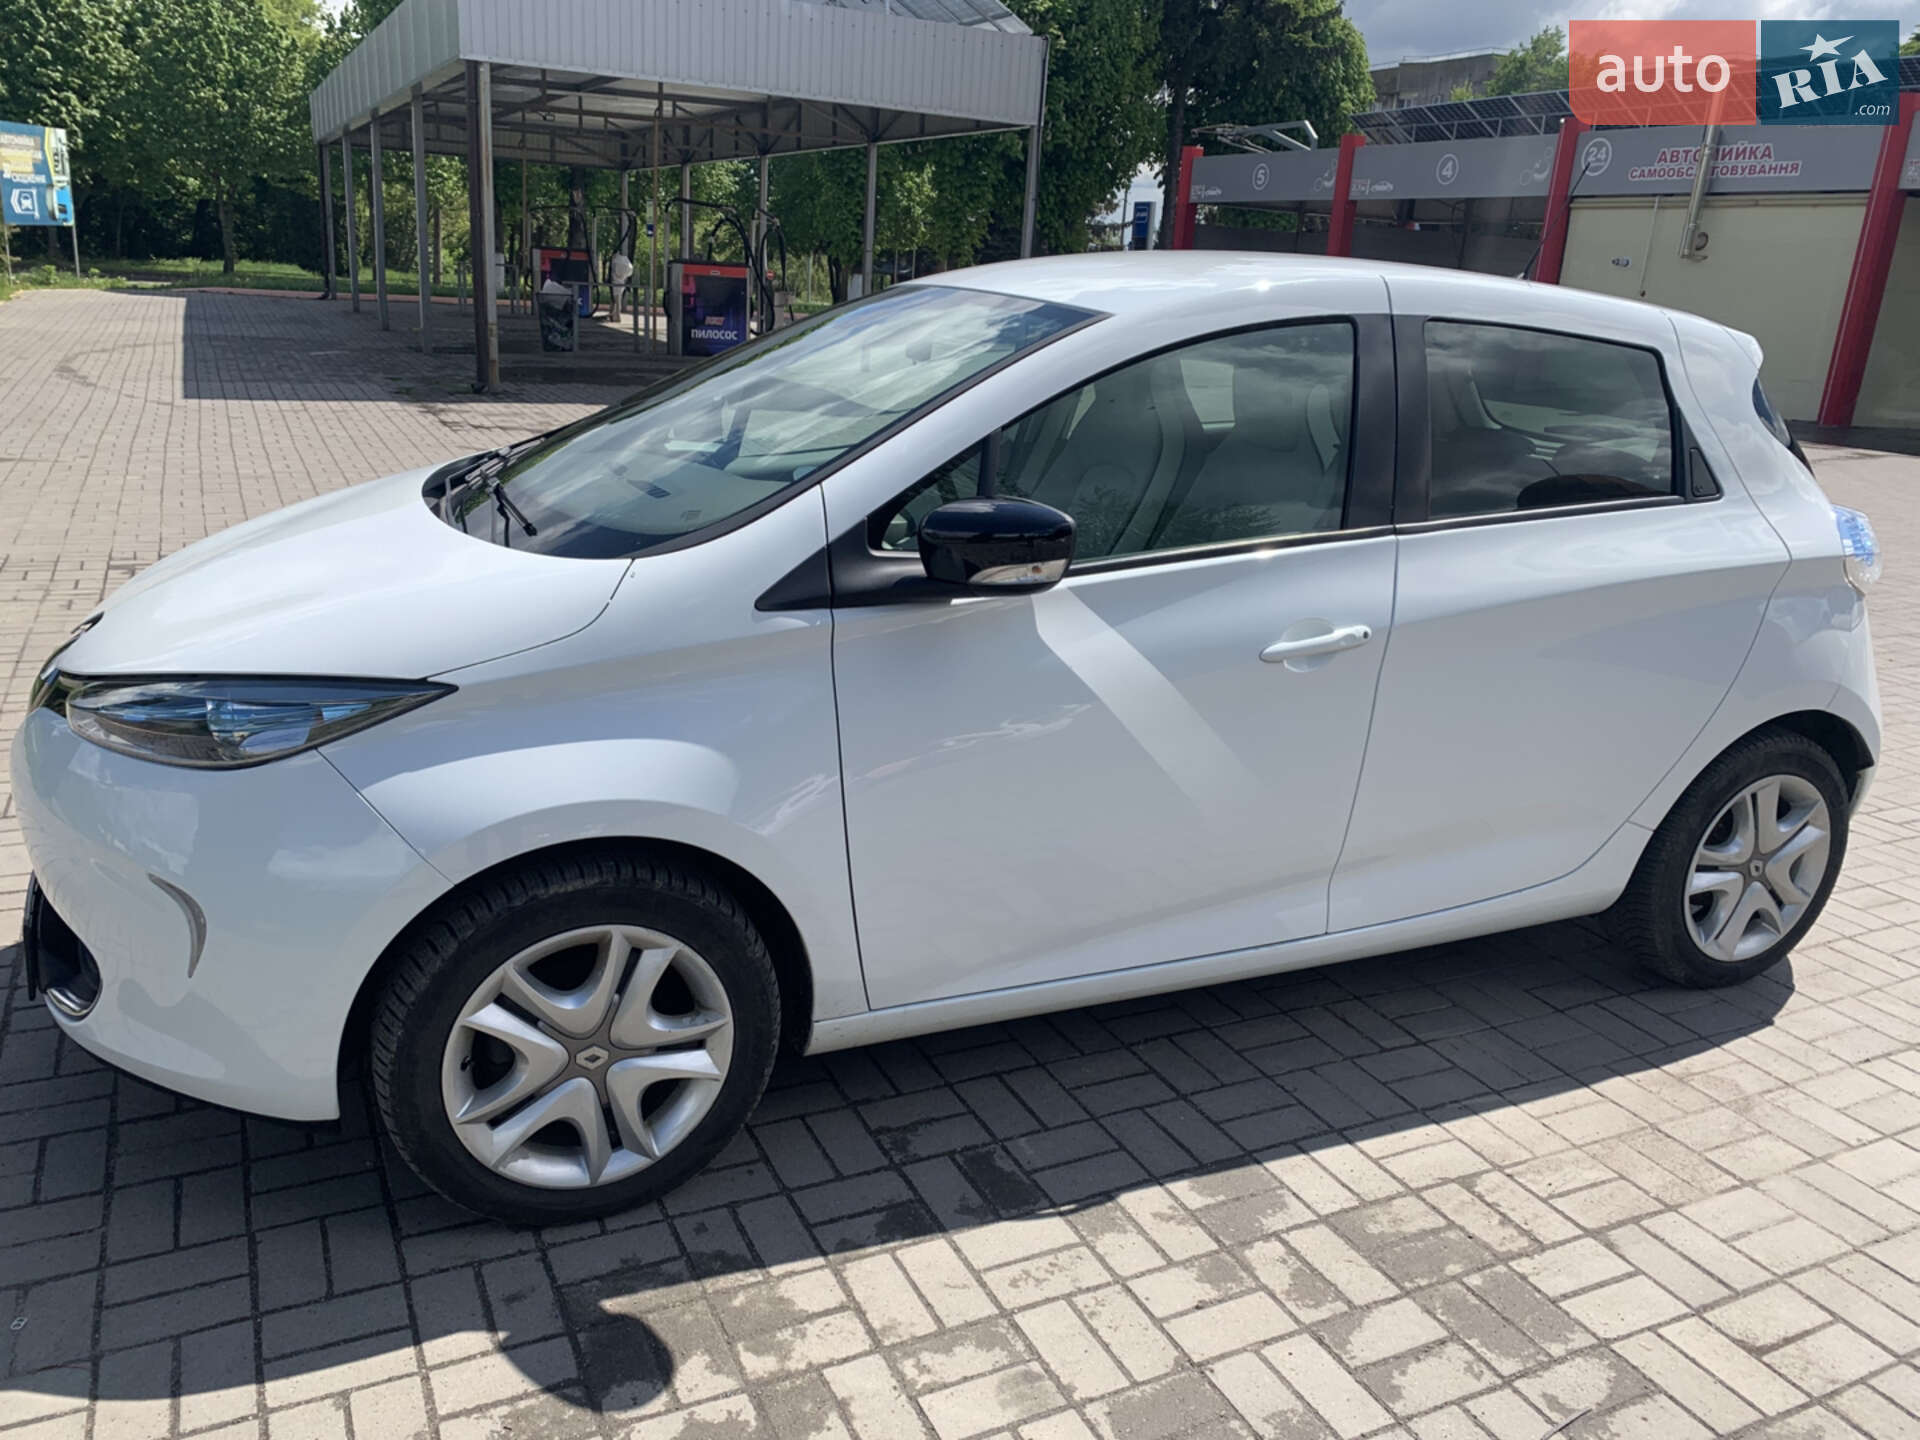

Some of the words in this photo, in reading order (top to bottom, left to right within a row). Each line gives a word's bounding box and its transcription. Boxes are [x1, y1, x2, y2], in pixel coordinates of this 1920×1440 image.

[1587, 146, 1607, 161] 24
[1440, 159, 1454, 177] 4
[1629, 163, 1800, 180] САМООБСГОВУВАННЯ
